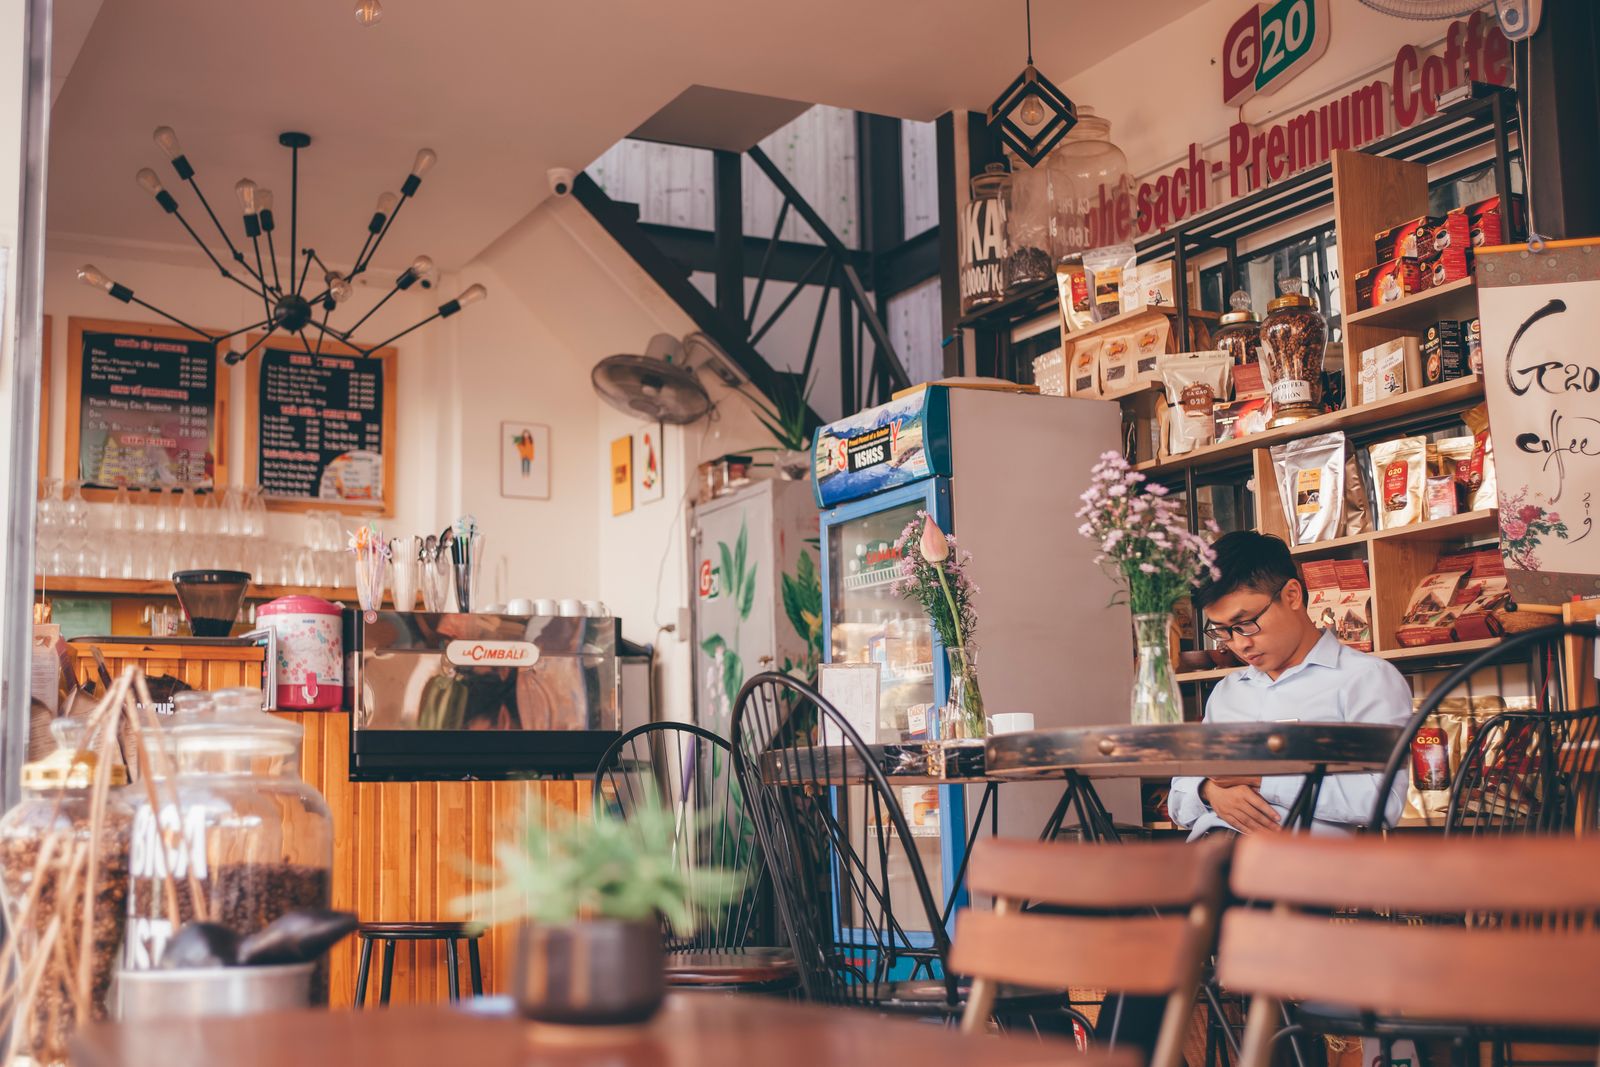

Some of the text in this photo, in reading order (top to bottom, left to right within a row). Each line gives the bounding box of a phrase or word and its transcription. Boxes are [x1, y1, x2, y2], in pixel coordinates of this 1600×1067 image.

[1229, 0, 1308, 79] G20
[1138, 143, 1206, 234] sạch
[1230, 80, 1384, 197] Premium
[472, 645, 525, 661] CIMBALI
[1416, 736, 1440, 744] G20
